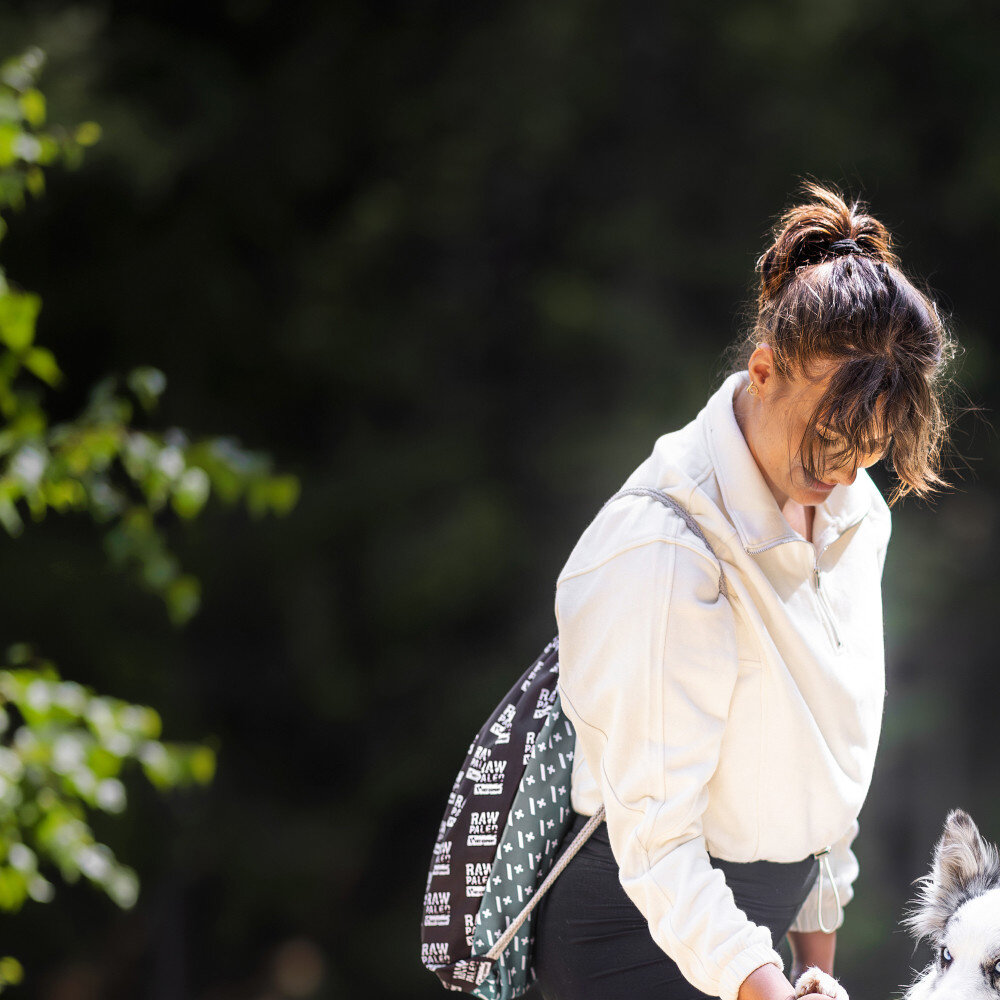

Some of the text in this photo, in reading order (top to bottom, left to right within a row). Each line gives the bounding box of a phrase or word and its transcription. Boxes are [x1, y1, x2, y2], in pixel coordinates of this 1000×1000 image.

[471, 811, 500, 825] RAW
[469, 824, 499, 834] PALEO
[465, 875, 488, 886] PALE
[424, 892, 451, 906] RAW
[421, 942, 449, 956] RAW
